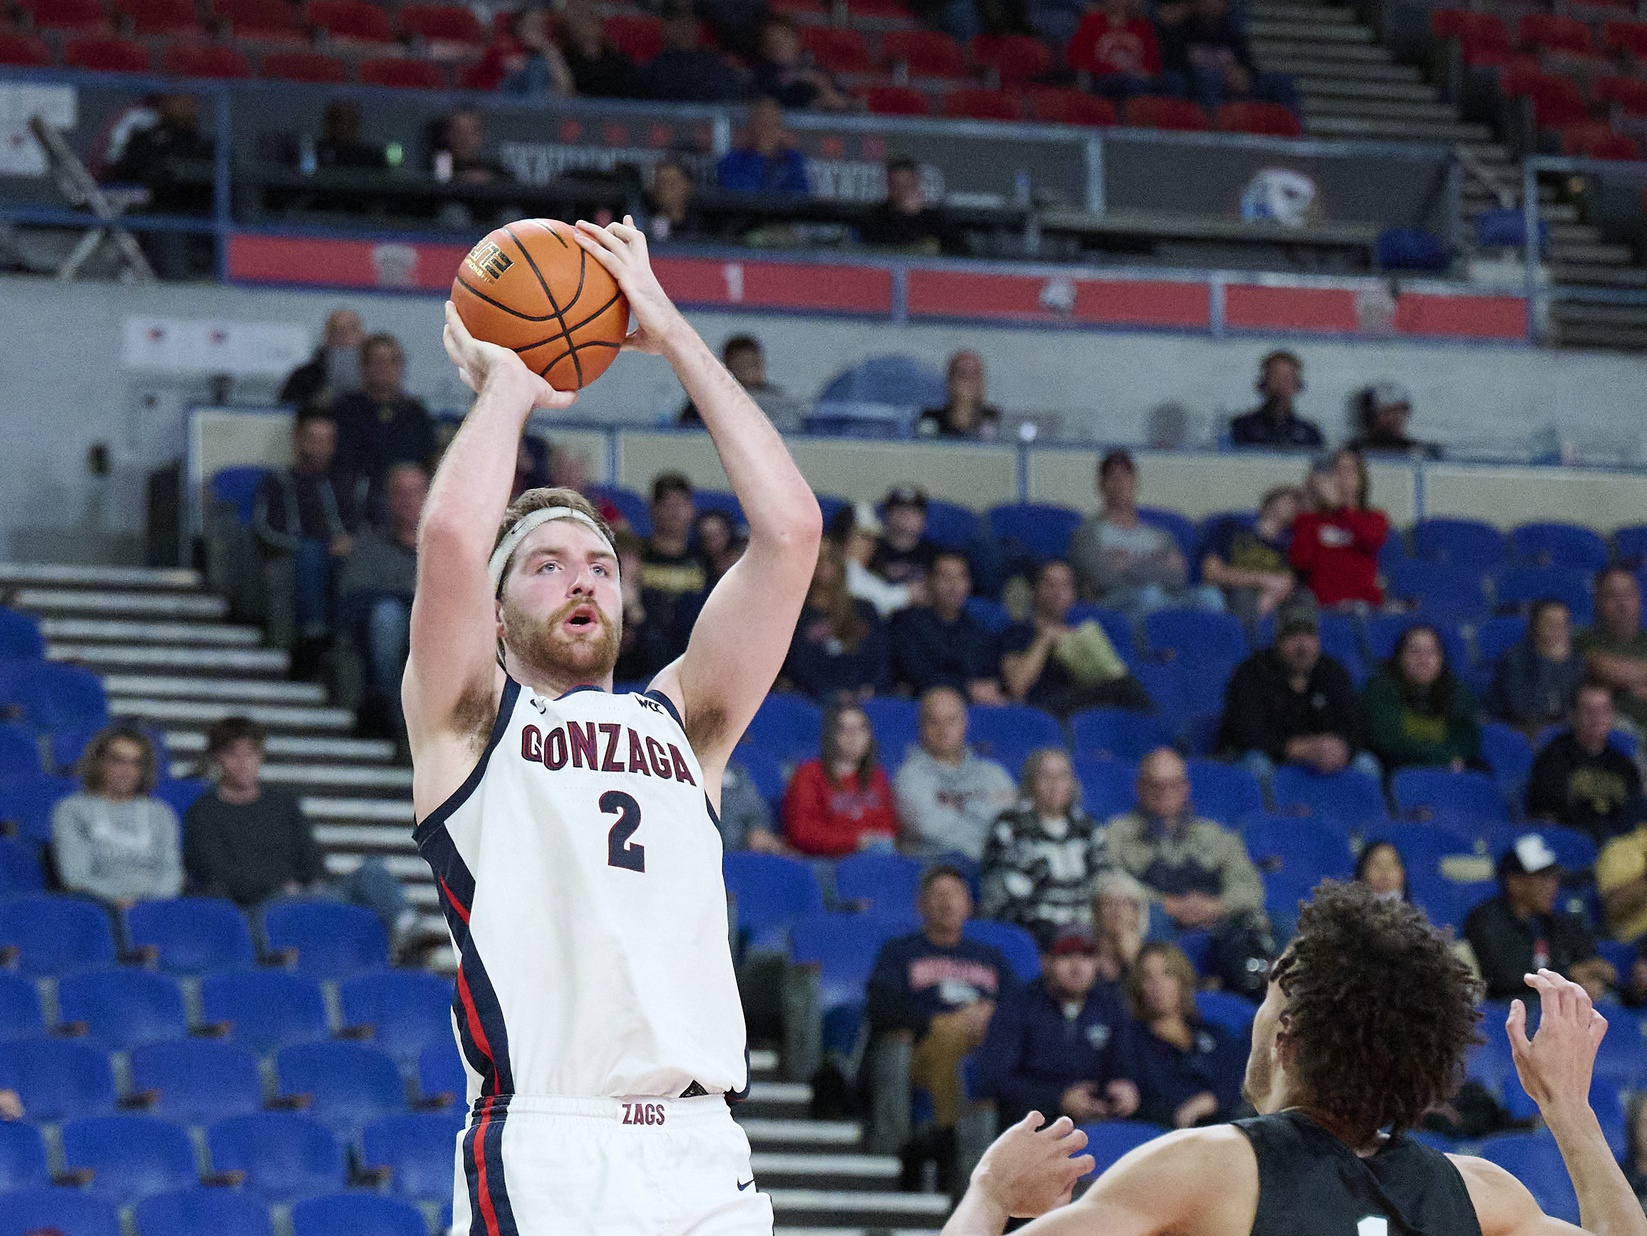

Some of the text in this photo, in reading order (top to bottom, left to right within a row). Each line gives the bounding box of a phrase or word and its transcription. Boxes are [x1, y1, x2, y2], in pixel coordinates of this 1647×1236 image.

[521, 721, 697, 787] GONZAGA
[598, 790, 646, 873] 2
[622, 1103, 666, 1126] ZAGS
